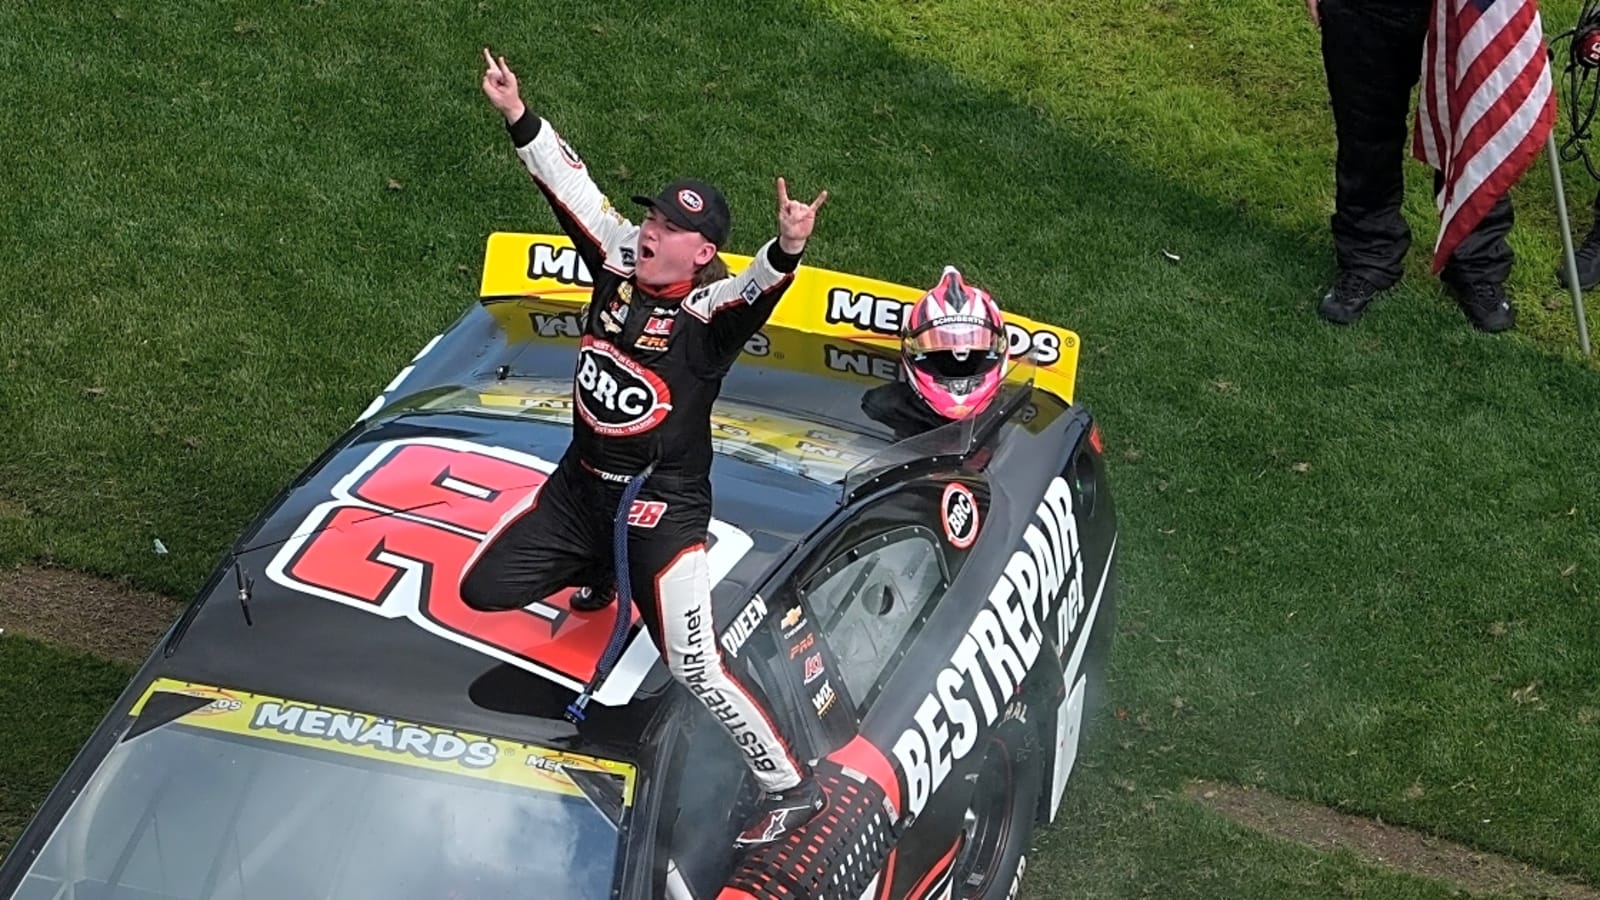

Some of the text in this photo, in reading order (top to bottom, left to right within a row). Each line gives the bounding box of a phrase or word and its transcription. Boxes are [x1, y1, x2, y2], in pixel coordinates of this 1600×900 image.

[932, 315, 985, 327] SCHUBERTH
[577, 353, 648, 416] BRC
[601, 471, 633, 484] QUEE
[948, 494, 971, 536] BRC
[720, 594, 768, 658] QUEEN
[893, 476, 1080, 826] BESTREPAIR
[684, 604, 776, 771] BESTREPAIR.net
[812, 679, 834, 710] WIX
